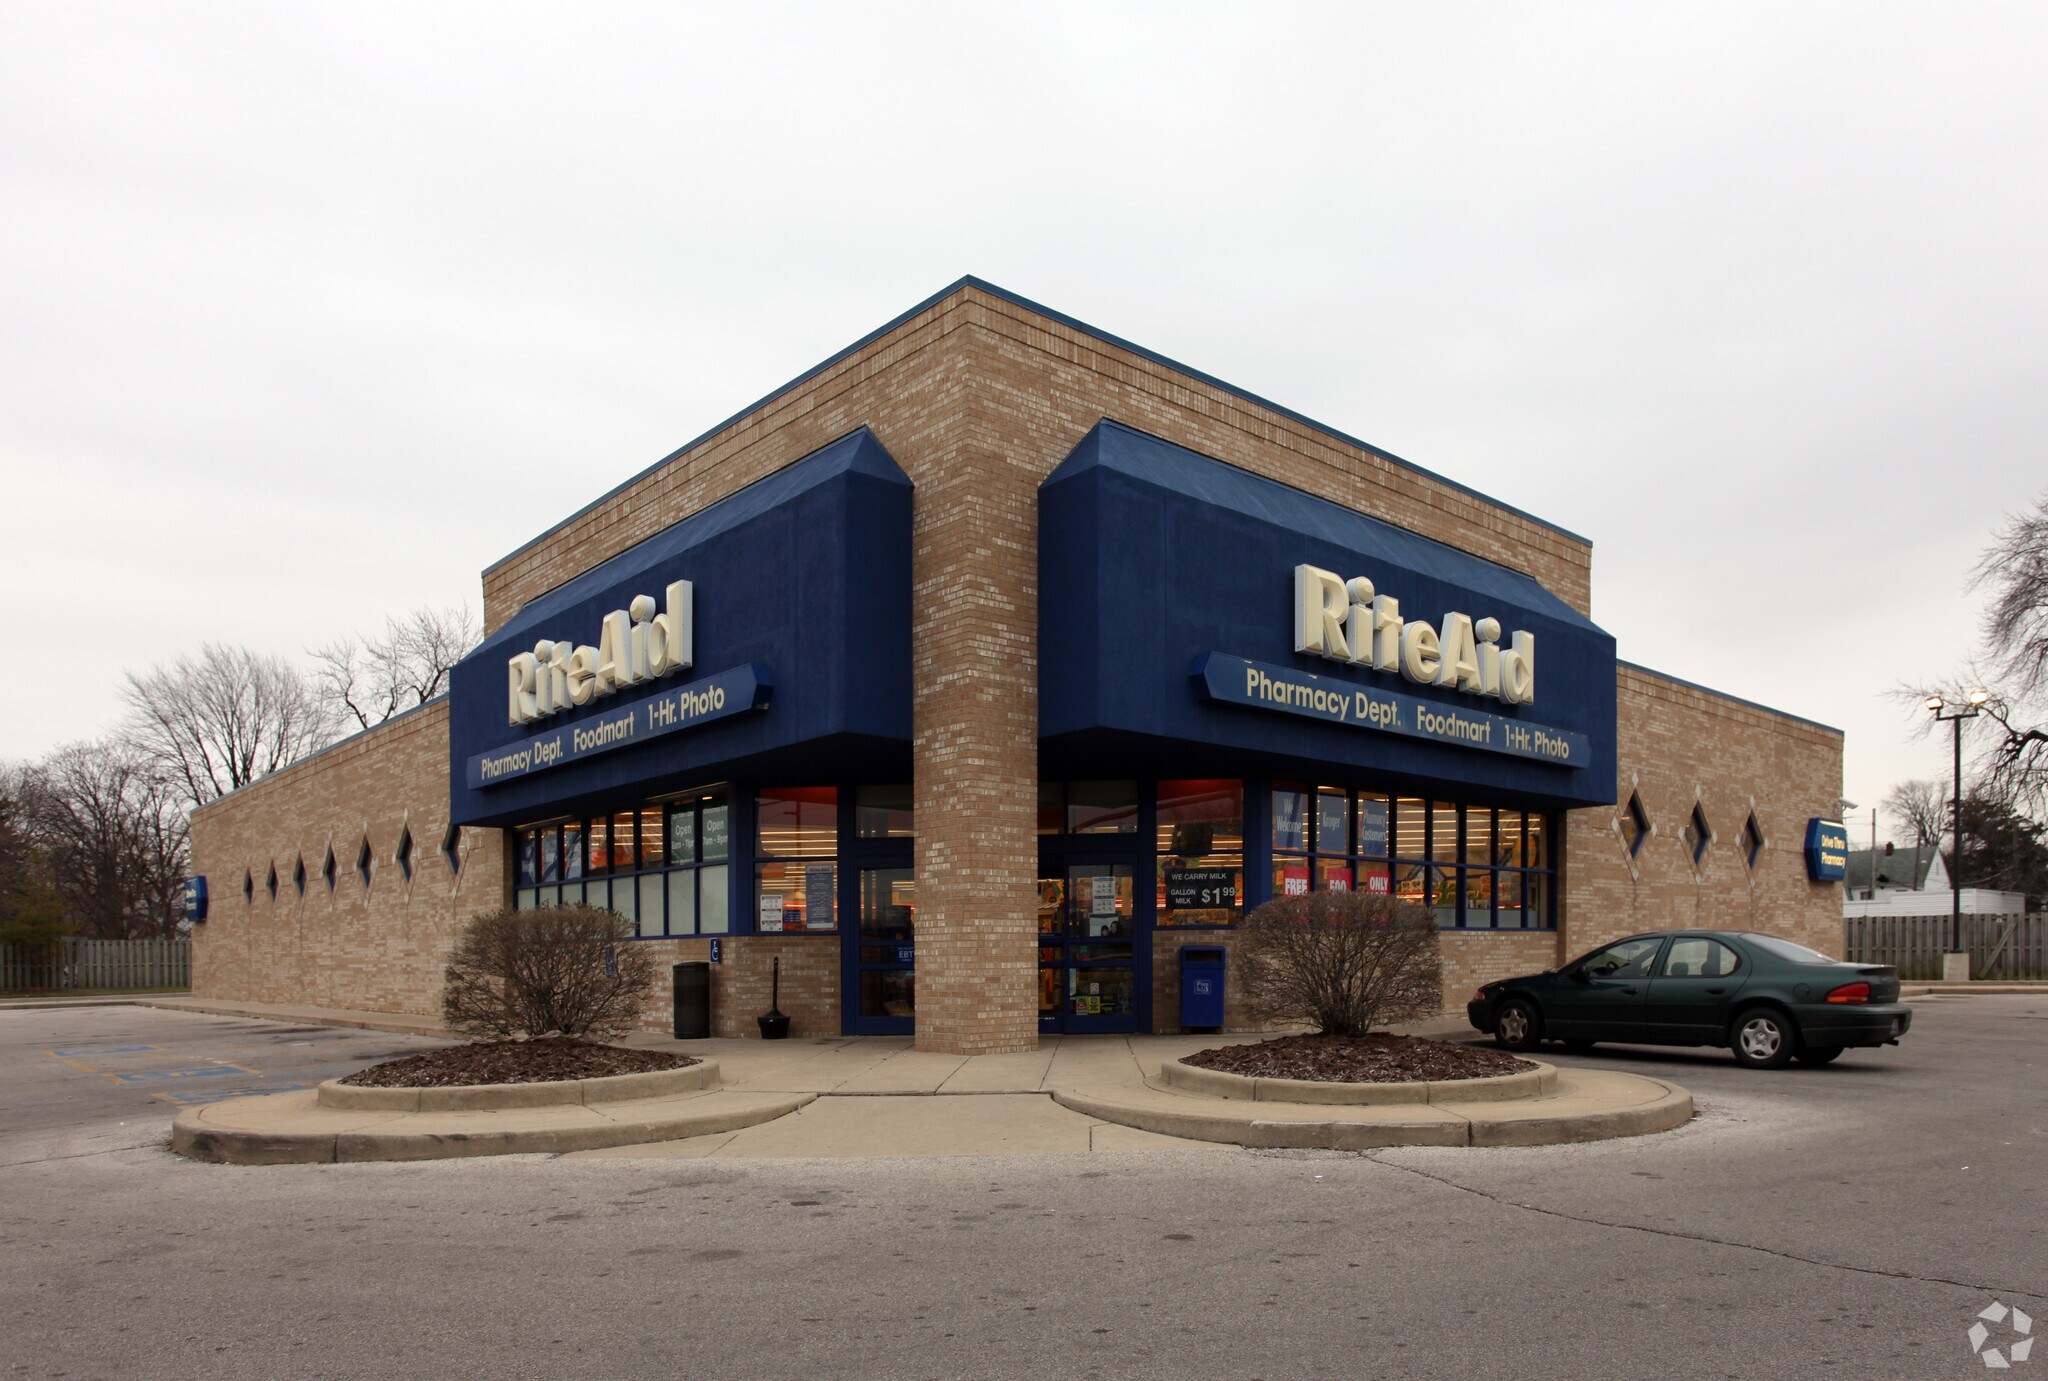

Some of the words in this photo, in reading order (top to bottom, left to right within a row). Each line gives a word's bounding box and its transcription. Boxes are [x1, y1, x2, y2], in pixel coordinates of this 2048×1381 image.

[1246, 668, 1350, 721] Pharmacy
[1355, 691, 1401, 729] Dept.
[1416, 705, 1491, 744] Foodmart
[1503, 723, 1532, 753] 1-Hr.
[1534, 730, 1570, 760] Photo
[481, 745, 531, 781] Pharmacy
[534, 739, 564, 766] Dept.
[573, 711, 635, 754] Foodmart
[647, 701, 678, 730] 1-Hr.
[680, 685, 725, 721] Photo
[1284, 798, 1294, 814] We
[1276, 815, 1302, 833] Welcome
[1322, 813, 1341, 831] Kroger
[1363, 808, 1386, 828] Pharmacy
[676, 825, 692, 837] Open
[707, 820, 724, 833] Open
[1362, 826, 1388, 842] Customers
[1822, 852, 1846, 869] Pharmacy
[1209, 872, 1227, 880] MILK
[1369, 876, 1388, 891] ONLY
[1170, 888, 1196, 896] GALLON
[1284, 877, 1308, 895] FREE
